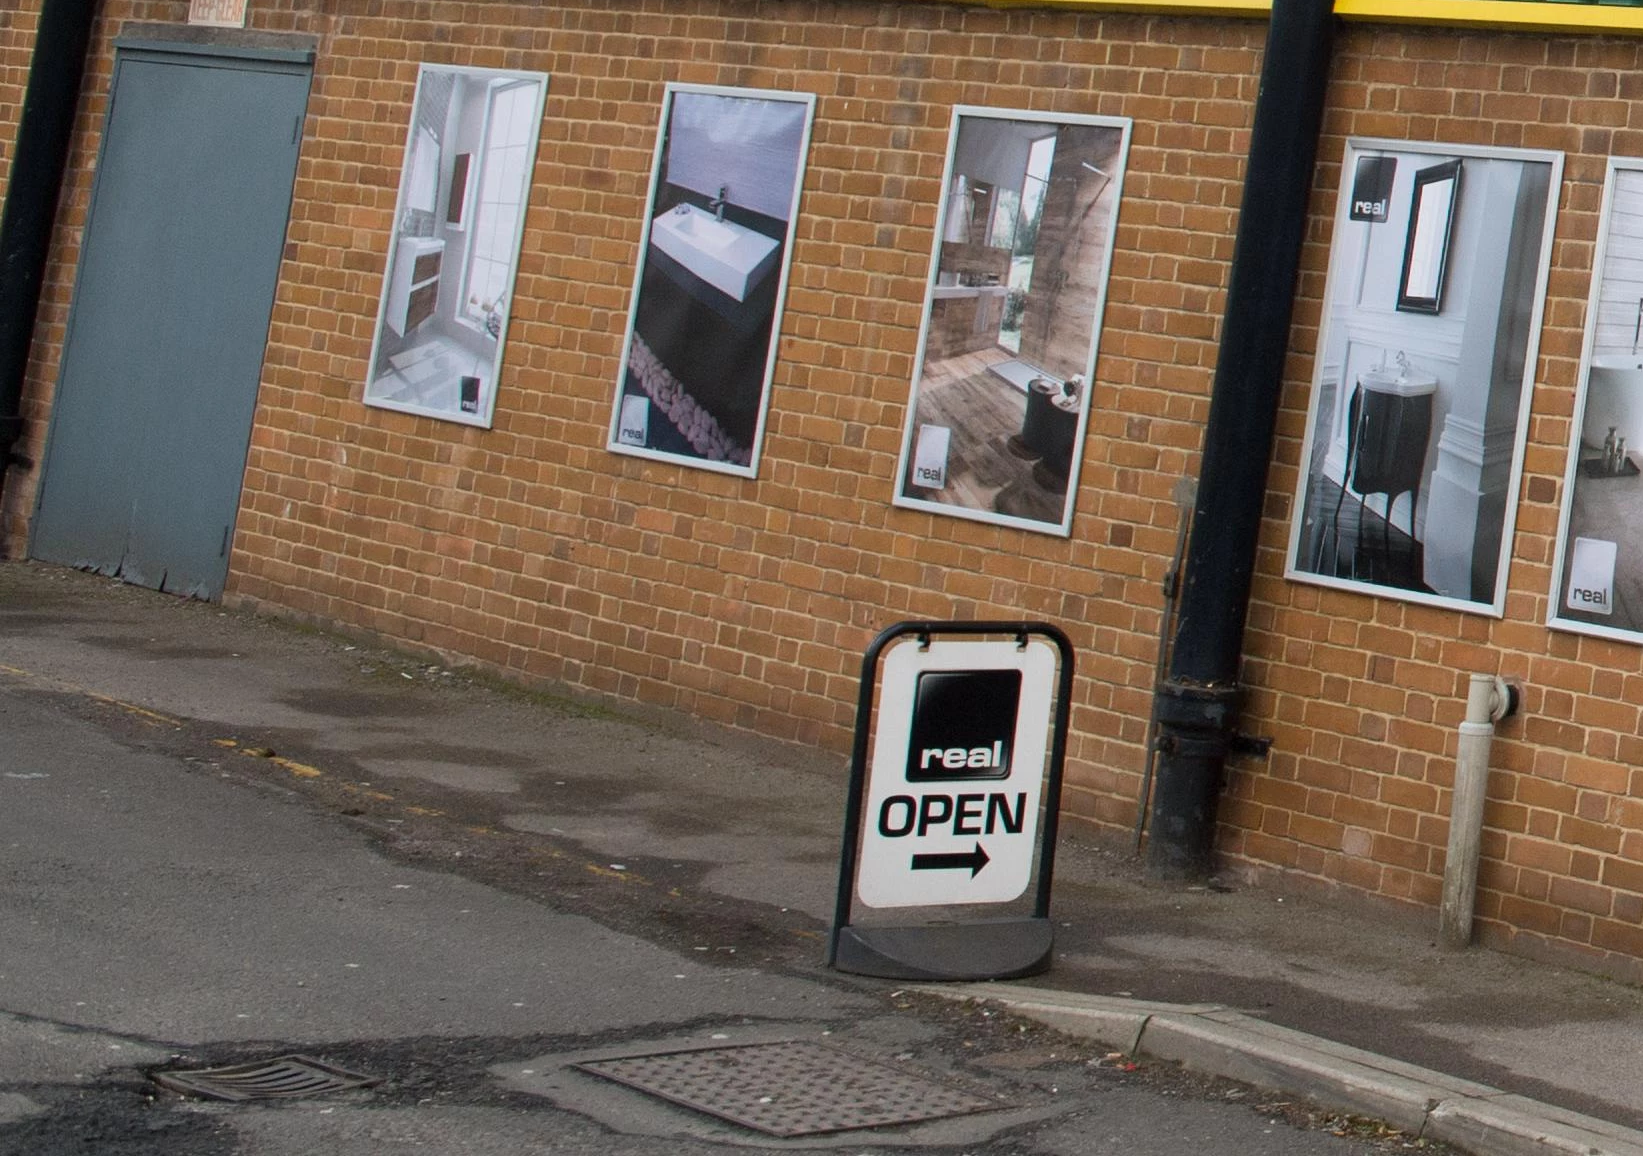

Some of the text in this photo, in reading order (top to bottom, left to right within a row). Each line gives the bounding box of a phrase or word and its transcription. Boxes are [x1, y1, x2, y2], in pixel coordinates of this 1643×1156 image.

[1354, 197, 1386, 218] real
[622, 428, 644, 439] real
[917, 467, 941, 481] real
[1572, 585, 1608, 605] real
[920, 740, 1002, 769] real
[878, 792, 1027, 838] OPEN
